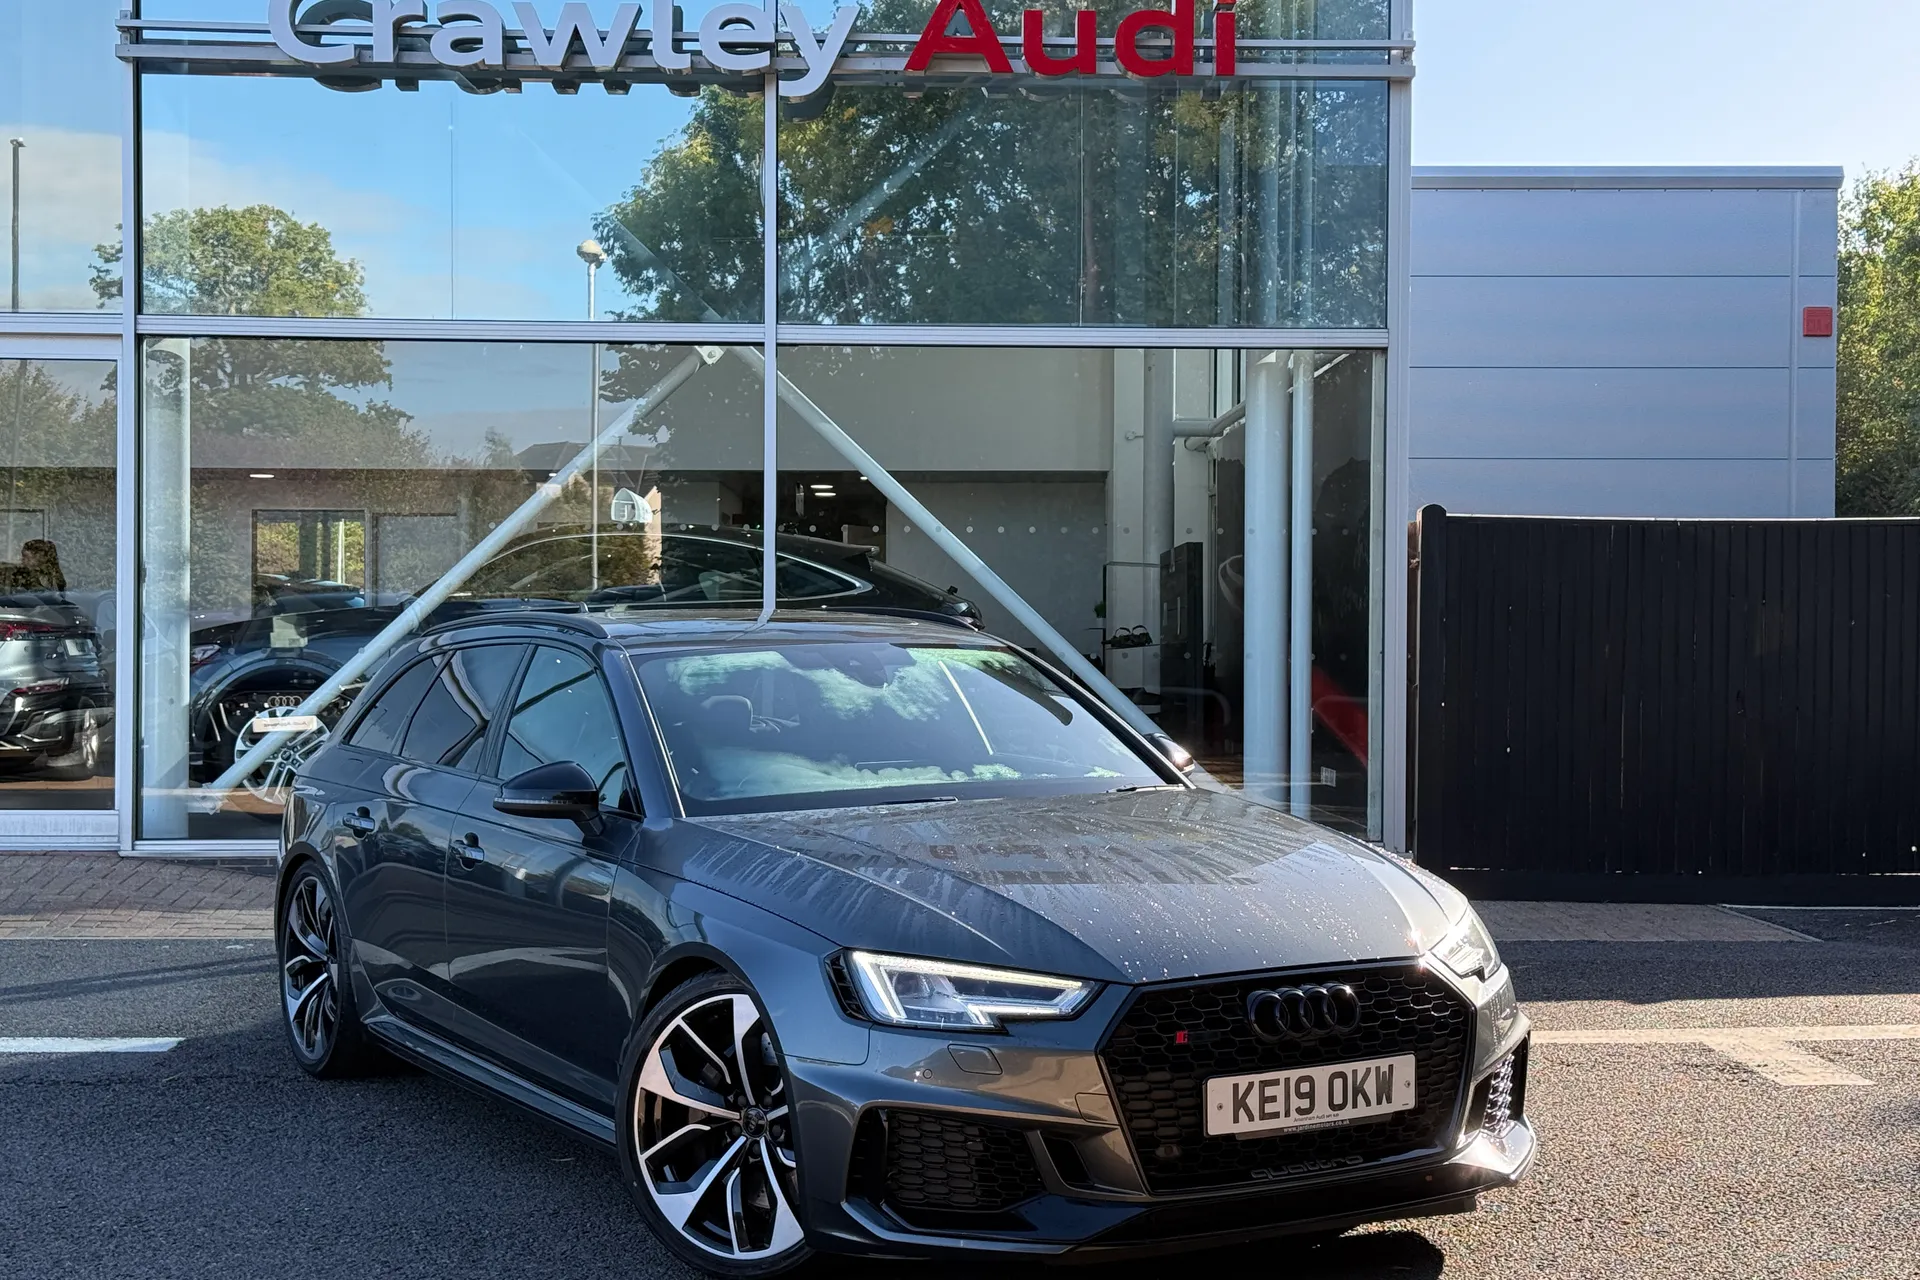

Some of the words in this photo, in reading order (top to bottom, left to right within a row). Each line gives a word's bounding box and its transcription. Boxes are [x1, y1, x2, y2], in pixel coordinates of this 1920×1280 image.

[268, 0, 860, 96] Crawley
[904, 0, 1236, 76] Audi
[1232, 1075, 1316, 1124] KE19
[1327, 1064, 1395, 1112] OKW
[1250, 1155, 1364, 1180] quattro
